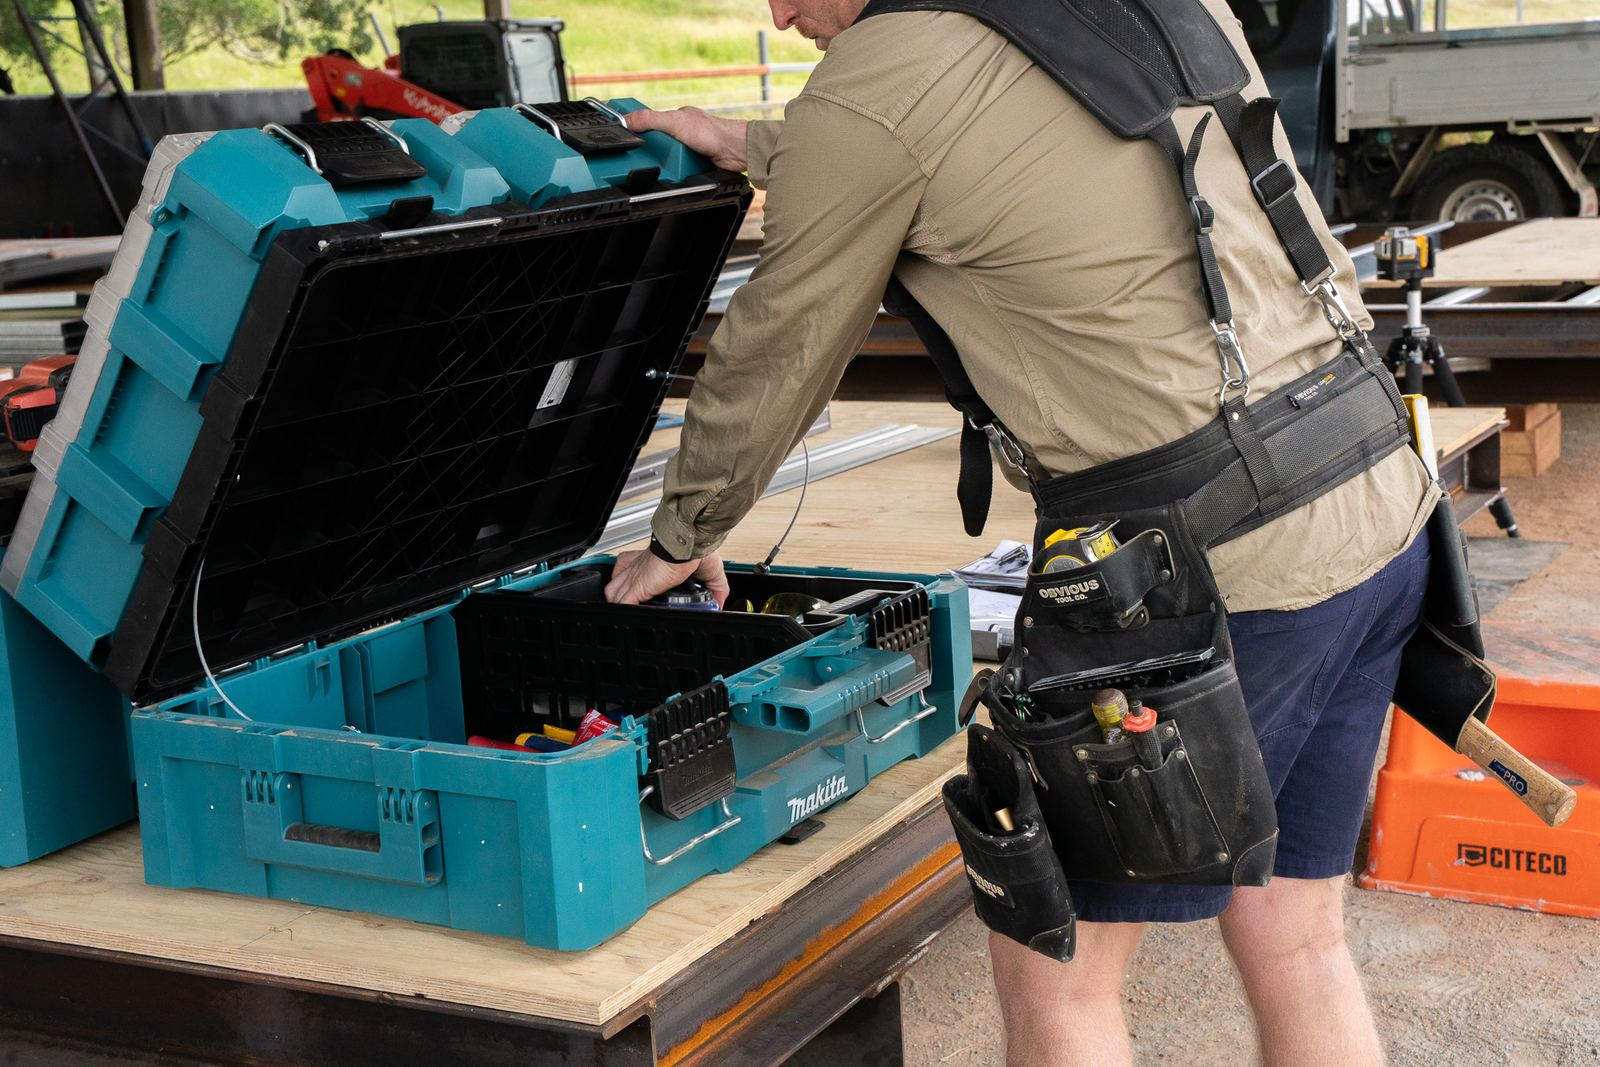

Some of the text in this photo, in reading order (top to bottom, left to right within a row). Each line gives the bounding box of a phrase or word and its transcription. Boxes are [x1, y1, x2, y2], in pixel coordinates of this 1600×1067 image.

[1038, 579, 1100, 599] OBVIOUS
[1054, 593, 1088, 604] TOOL CO.
[1503, 770, 1524, 792] PRO
[1490, 847, 1567, 876] CITECO
